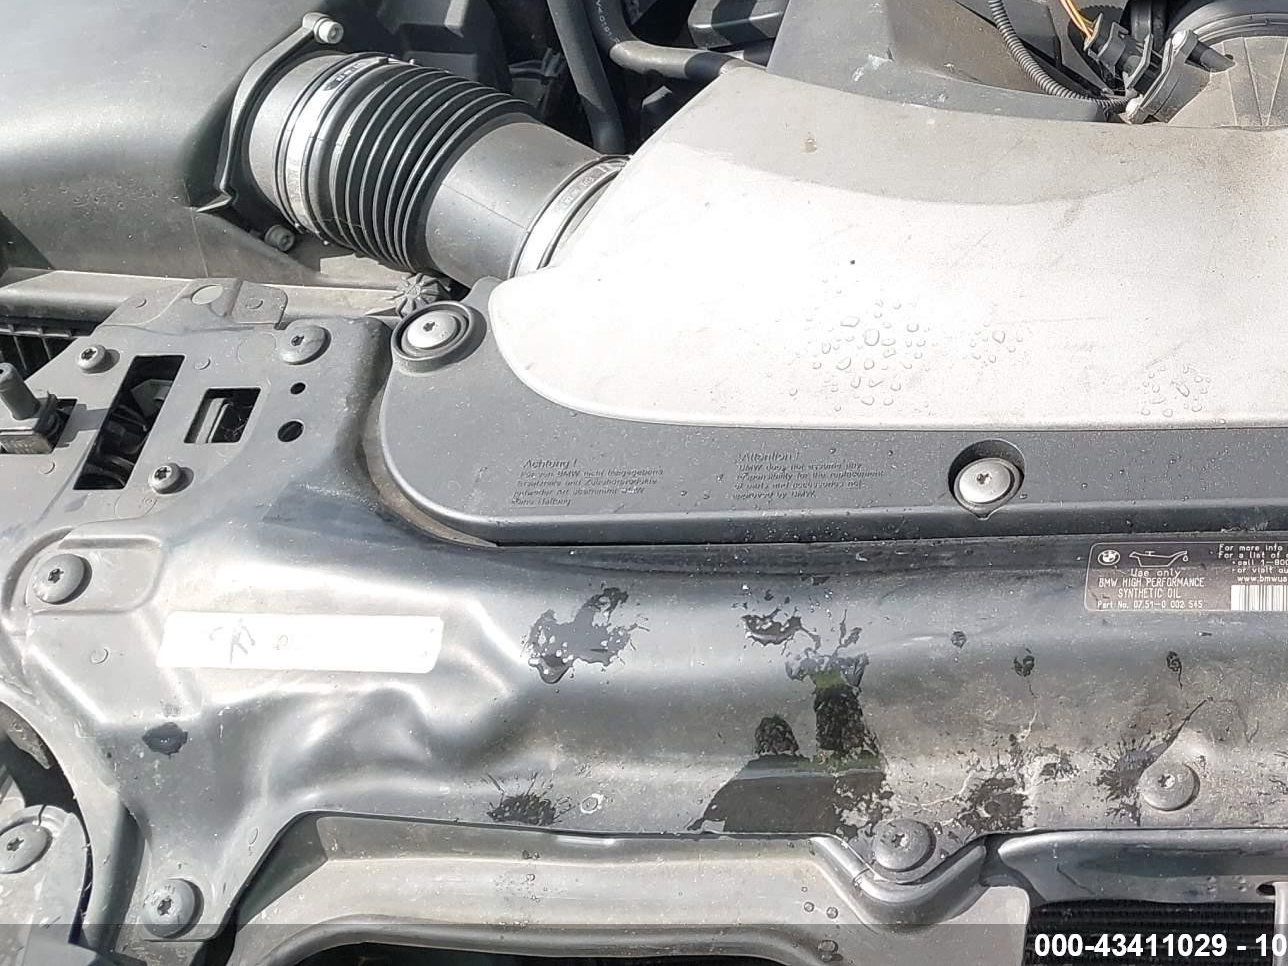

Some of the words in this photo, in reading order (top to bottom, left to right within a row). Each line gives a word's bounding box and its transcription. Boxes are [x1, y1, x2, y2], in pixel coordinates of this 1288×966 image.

[523, 458, 570, 470] Achtung
[1219, 544, 1234, 552] For
[1265, 544, 1283, 552] info
[1130, 568, 1150, 577] Use
[1156, 567, 1181, 579] only
[1251, 566, 1273, 574] visit
[1099, 577, 1118, 588] BMW
[1122, 577, 1141, 587] HIGH
[1146, 577, 1205, 587] PERFORMANCE
[1117, 588, 1162, 599] SYNTHETIC
[1167, 588, 1181, 598] OIL
[1097, 600, 1113, 609] Part
